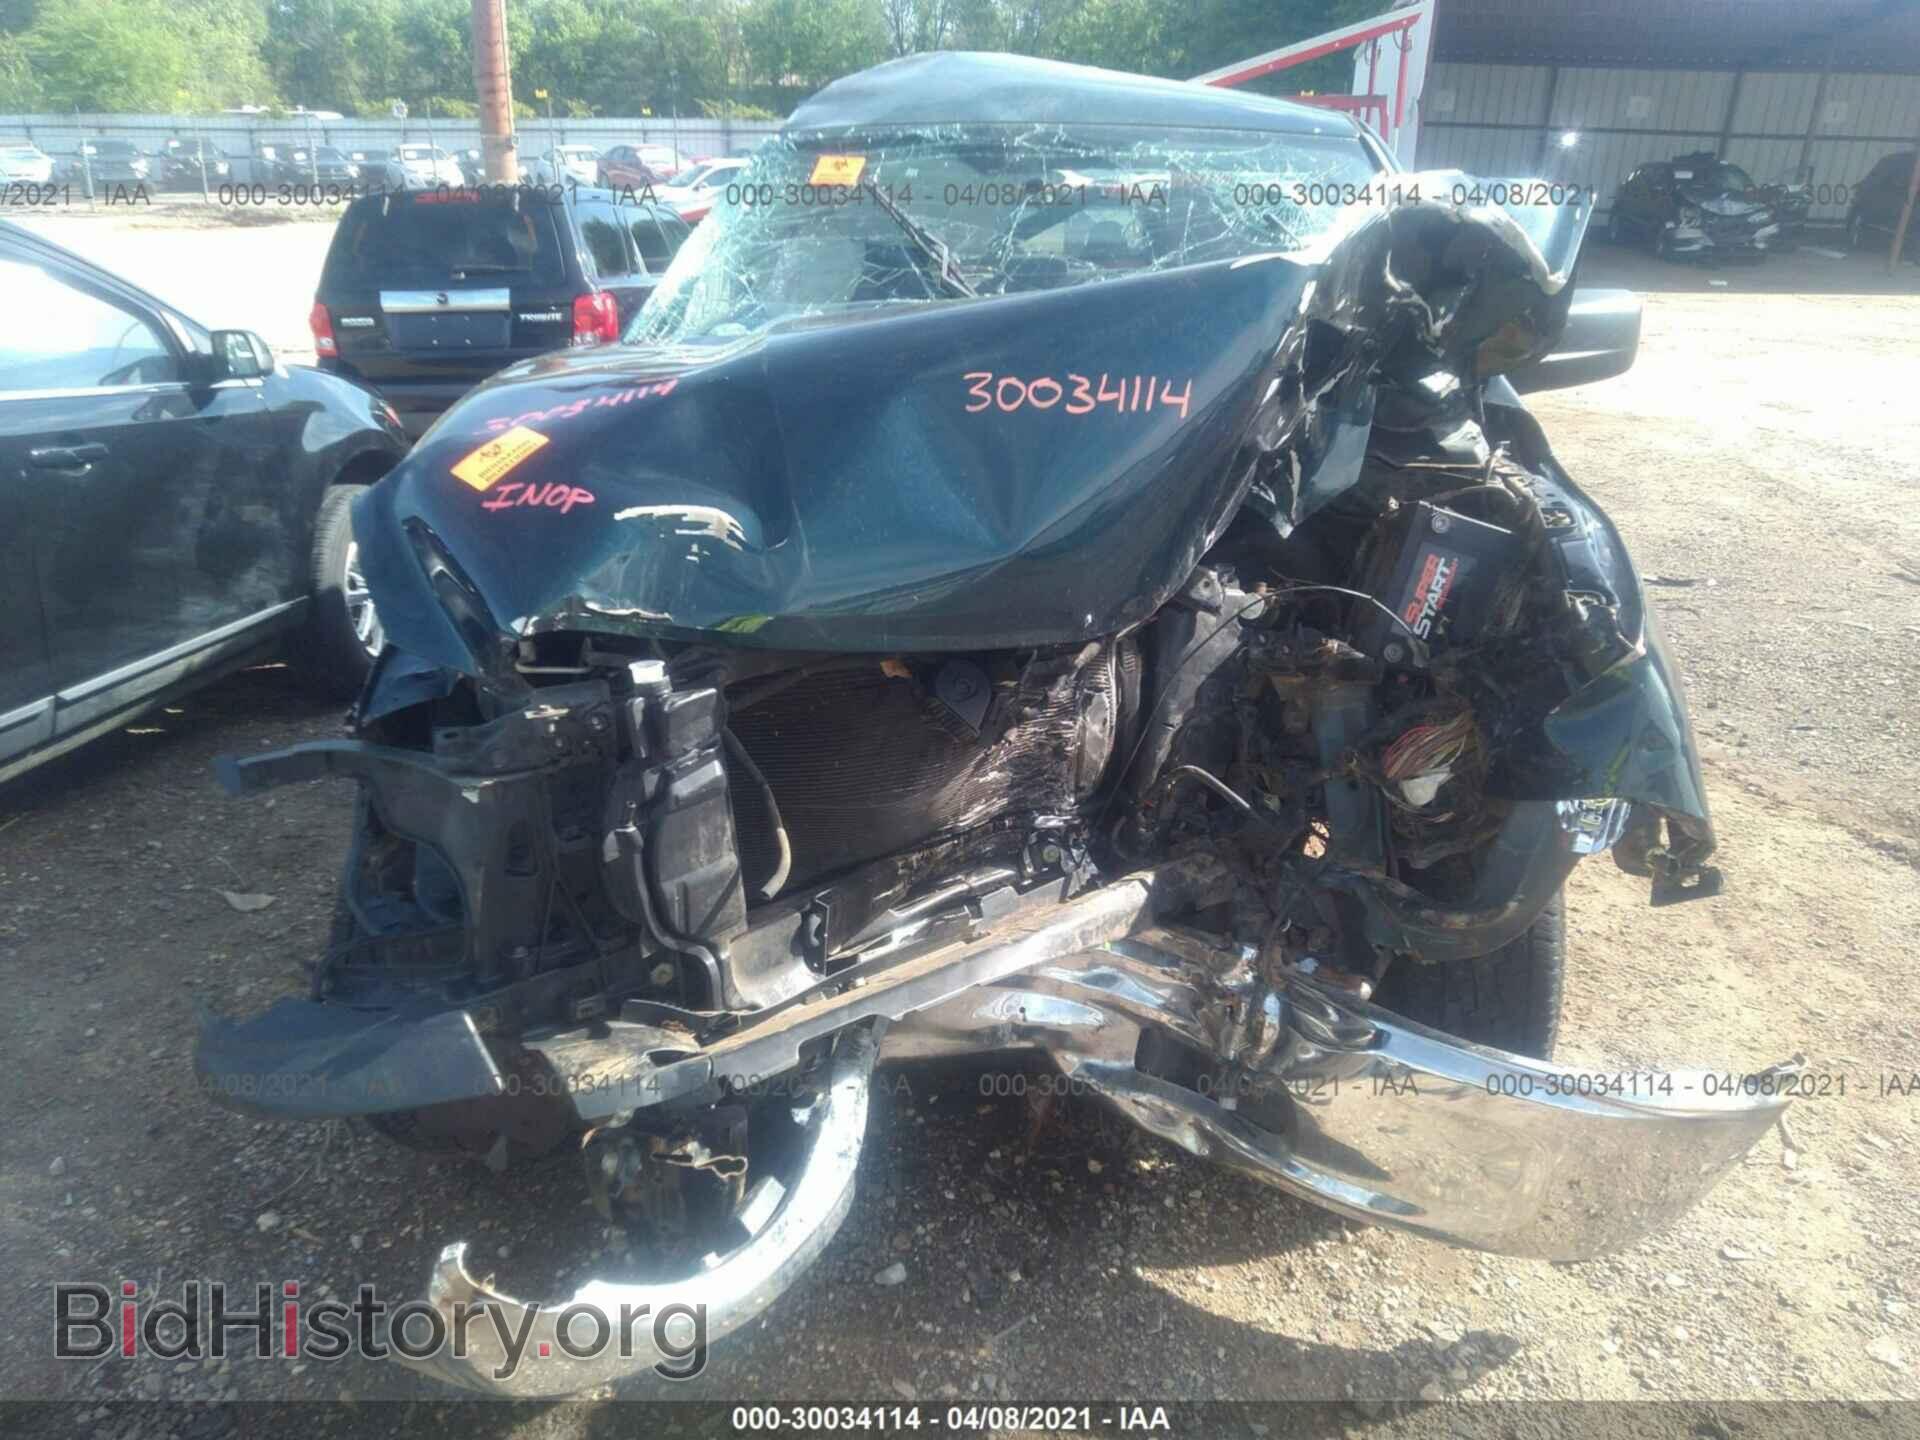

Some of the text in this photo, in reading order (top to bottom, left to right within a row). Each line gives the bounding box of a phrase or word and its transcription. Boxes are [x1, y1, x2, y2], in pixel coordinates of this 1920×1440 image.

[963, 372, 1192, 418] 30034114
[481, 482, 595, 514] INOP
[1413, 557, 1451, 639] START
